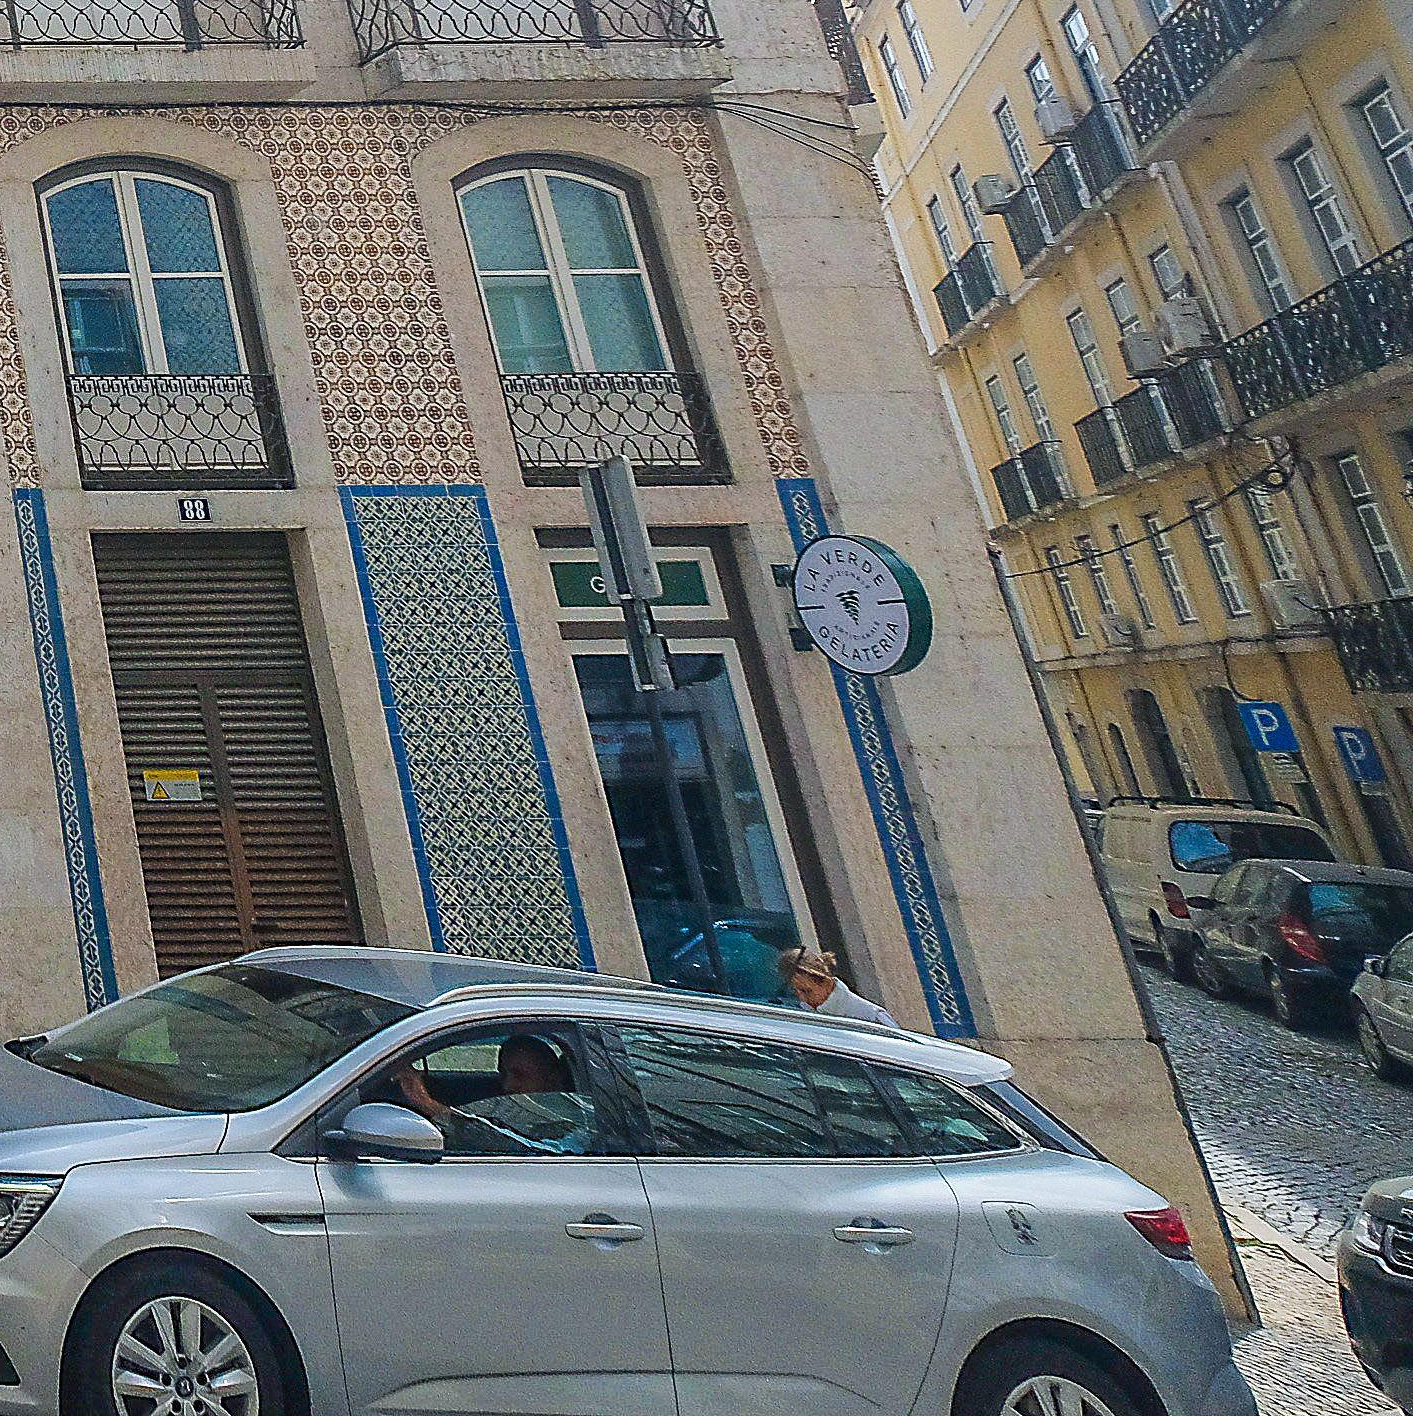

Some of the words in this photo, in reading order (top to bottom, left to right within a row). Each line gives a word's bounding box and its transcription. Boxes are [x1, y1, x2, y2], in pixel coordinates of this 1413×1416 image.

[183, 499, 206, 520] 88
[804, 567, 820, 592] LA
[821, 549, 885, 587] VERDE
[819, 621, 900, 662] GELATERIA
[1251, 708, 1280, 746] P
